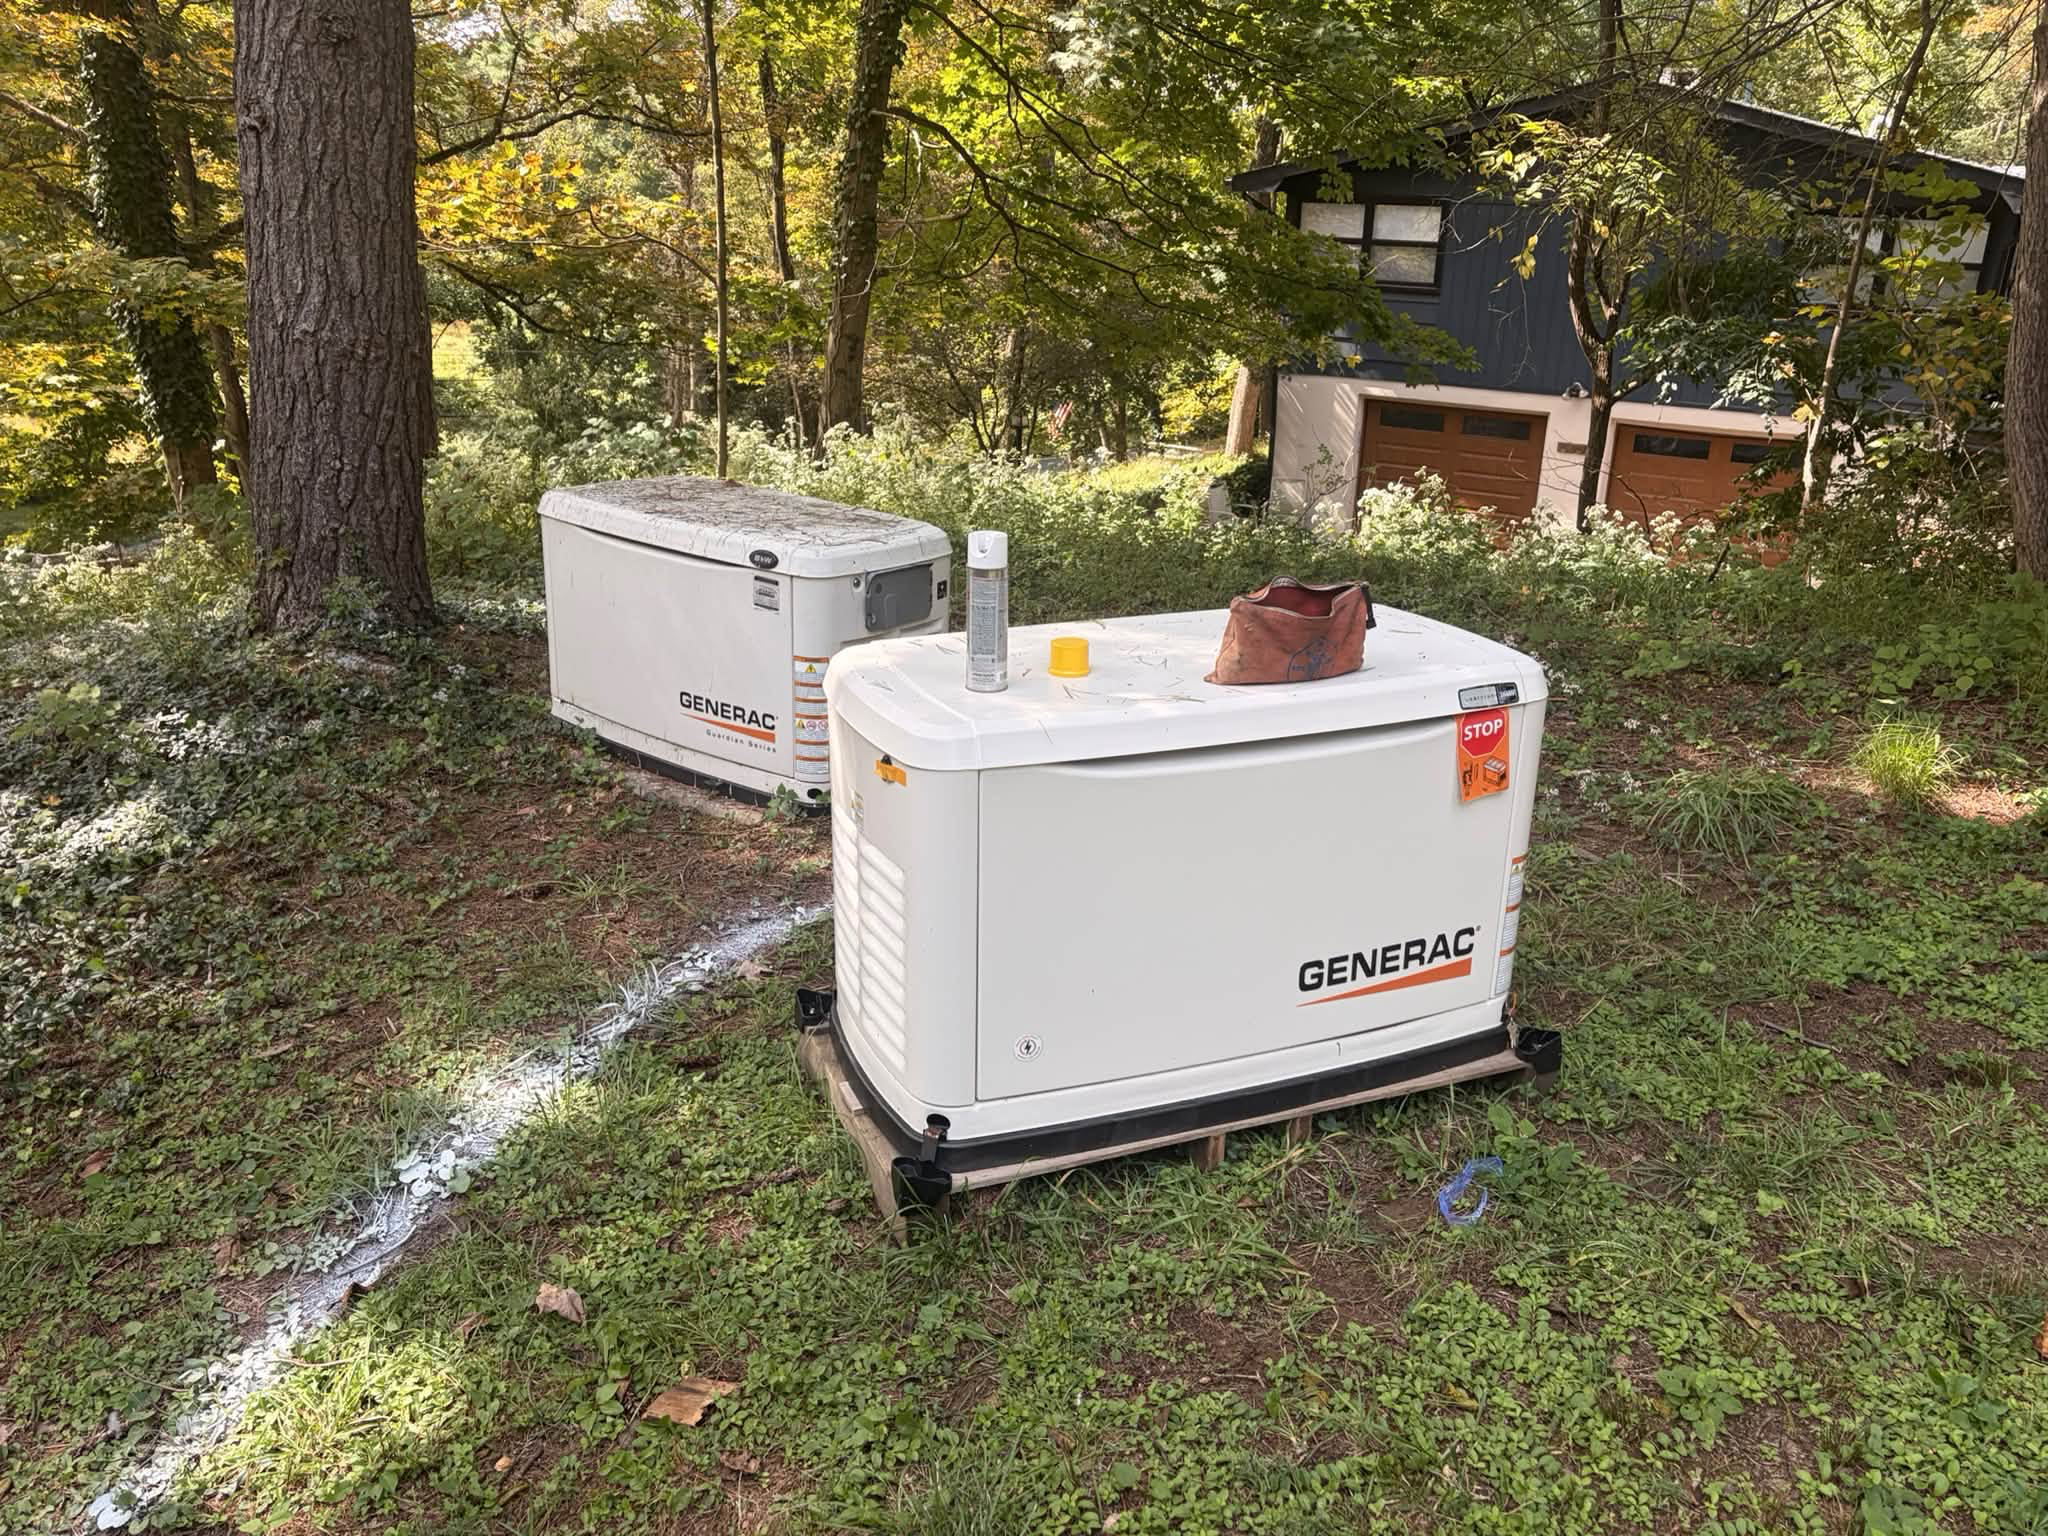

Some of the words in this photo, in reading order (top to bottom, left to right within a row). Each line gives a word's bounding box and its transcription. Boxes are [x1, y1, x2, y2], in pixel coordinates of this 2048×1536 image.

[680, 691, 776, 731] GENERAC
[706, 728, 744, 744] Guardian
[748, 740, 776, 752] Series
[1463, 718, 1503, 741] STOP
[1298, 926, 1474, 992] GENERAC
